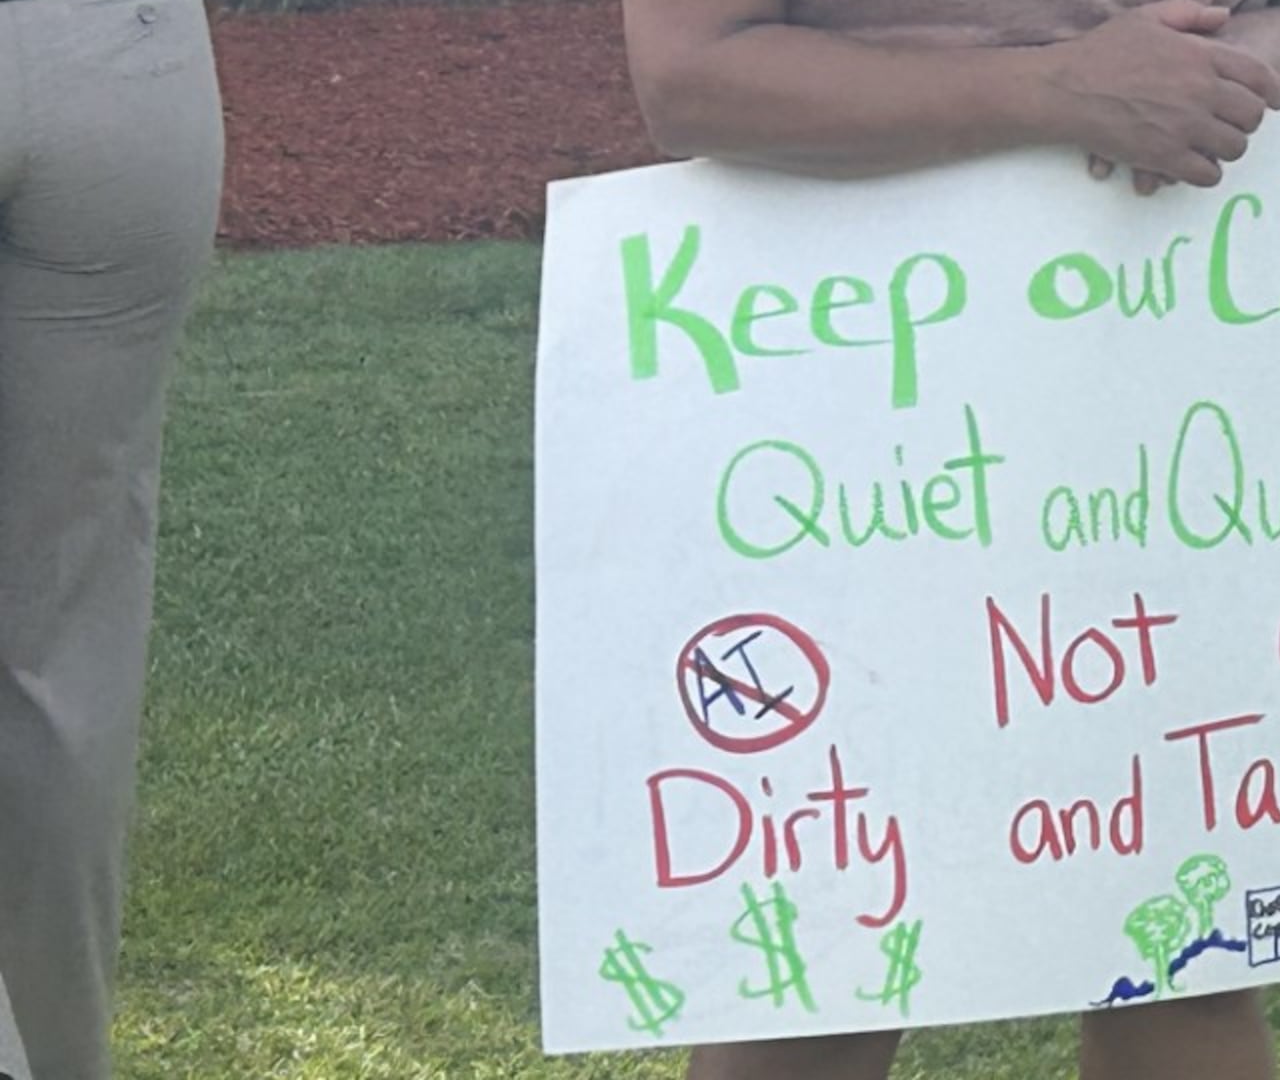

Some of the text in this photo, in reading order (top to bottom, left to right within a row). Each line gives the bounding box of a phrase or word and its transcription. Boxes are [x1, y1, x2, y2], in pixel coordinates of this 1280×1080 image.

[619, 225, 967, 409] Keep
[717, 404, 1004, 558] Quiet
[1042, 444, 1147, 551] and
[694, 630, 794, 728] AI
[986, 593, 1177, 727] Not
[647, 744, 907, 929] Dirty
[1010, 755, 1143, 863] and
